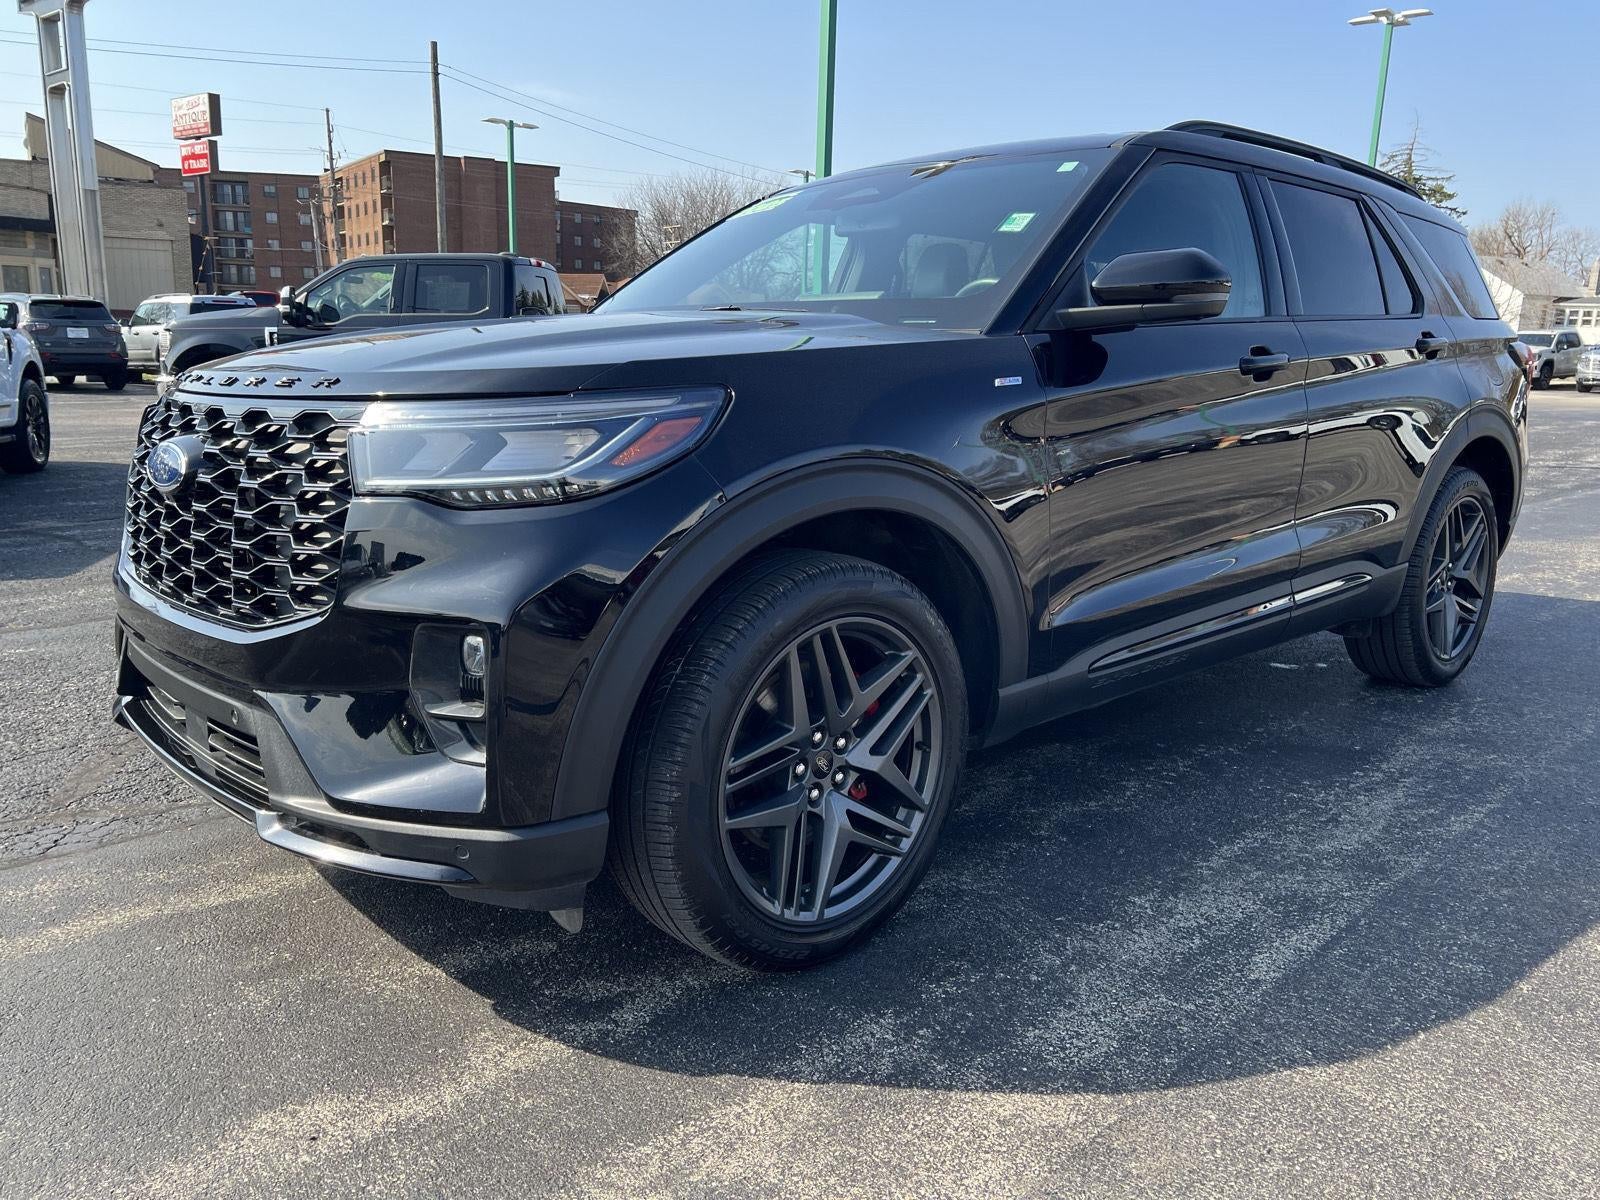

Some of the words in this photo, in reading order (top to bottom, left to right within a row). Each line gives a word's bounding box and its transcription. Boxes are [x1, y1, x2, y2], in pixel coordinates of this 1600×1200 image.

[174, 111, 208, 126] ANTIQUE
[181, 146, 191, 157] BUY
[194, 144, 208, 155] SELL
[189, 158, 207, 169] TRADE
